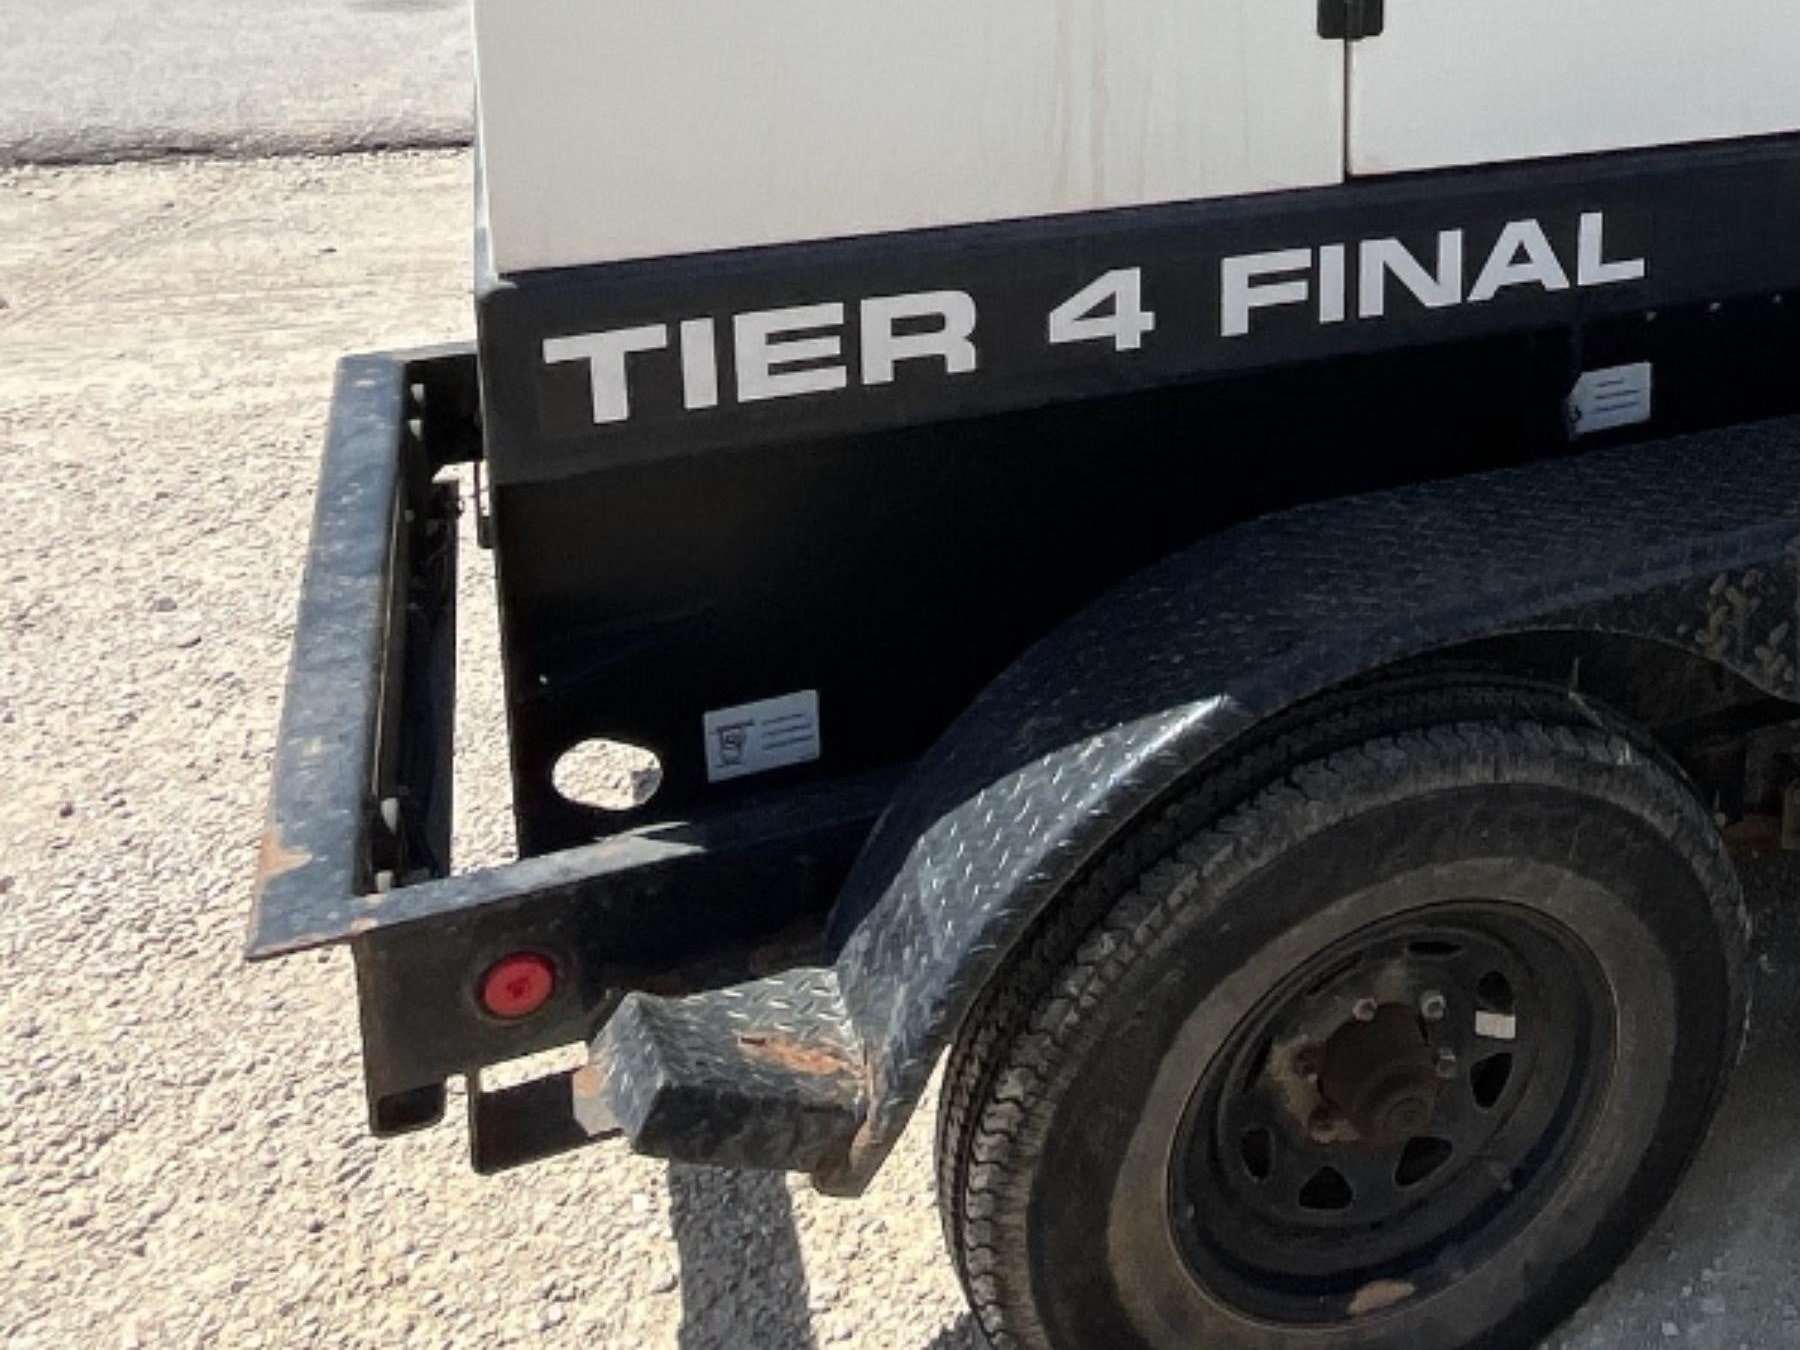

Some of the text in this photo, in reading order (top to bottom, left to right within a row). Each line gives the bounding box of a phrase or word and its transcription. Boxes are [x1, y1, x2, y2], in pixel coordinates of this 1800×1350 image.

[542, 211, 1646, 424] TIER 4 FINAL
